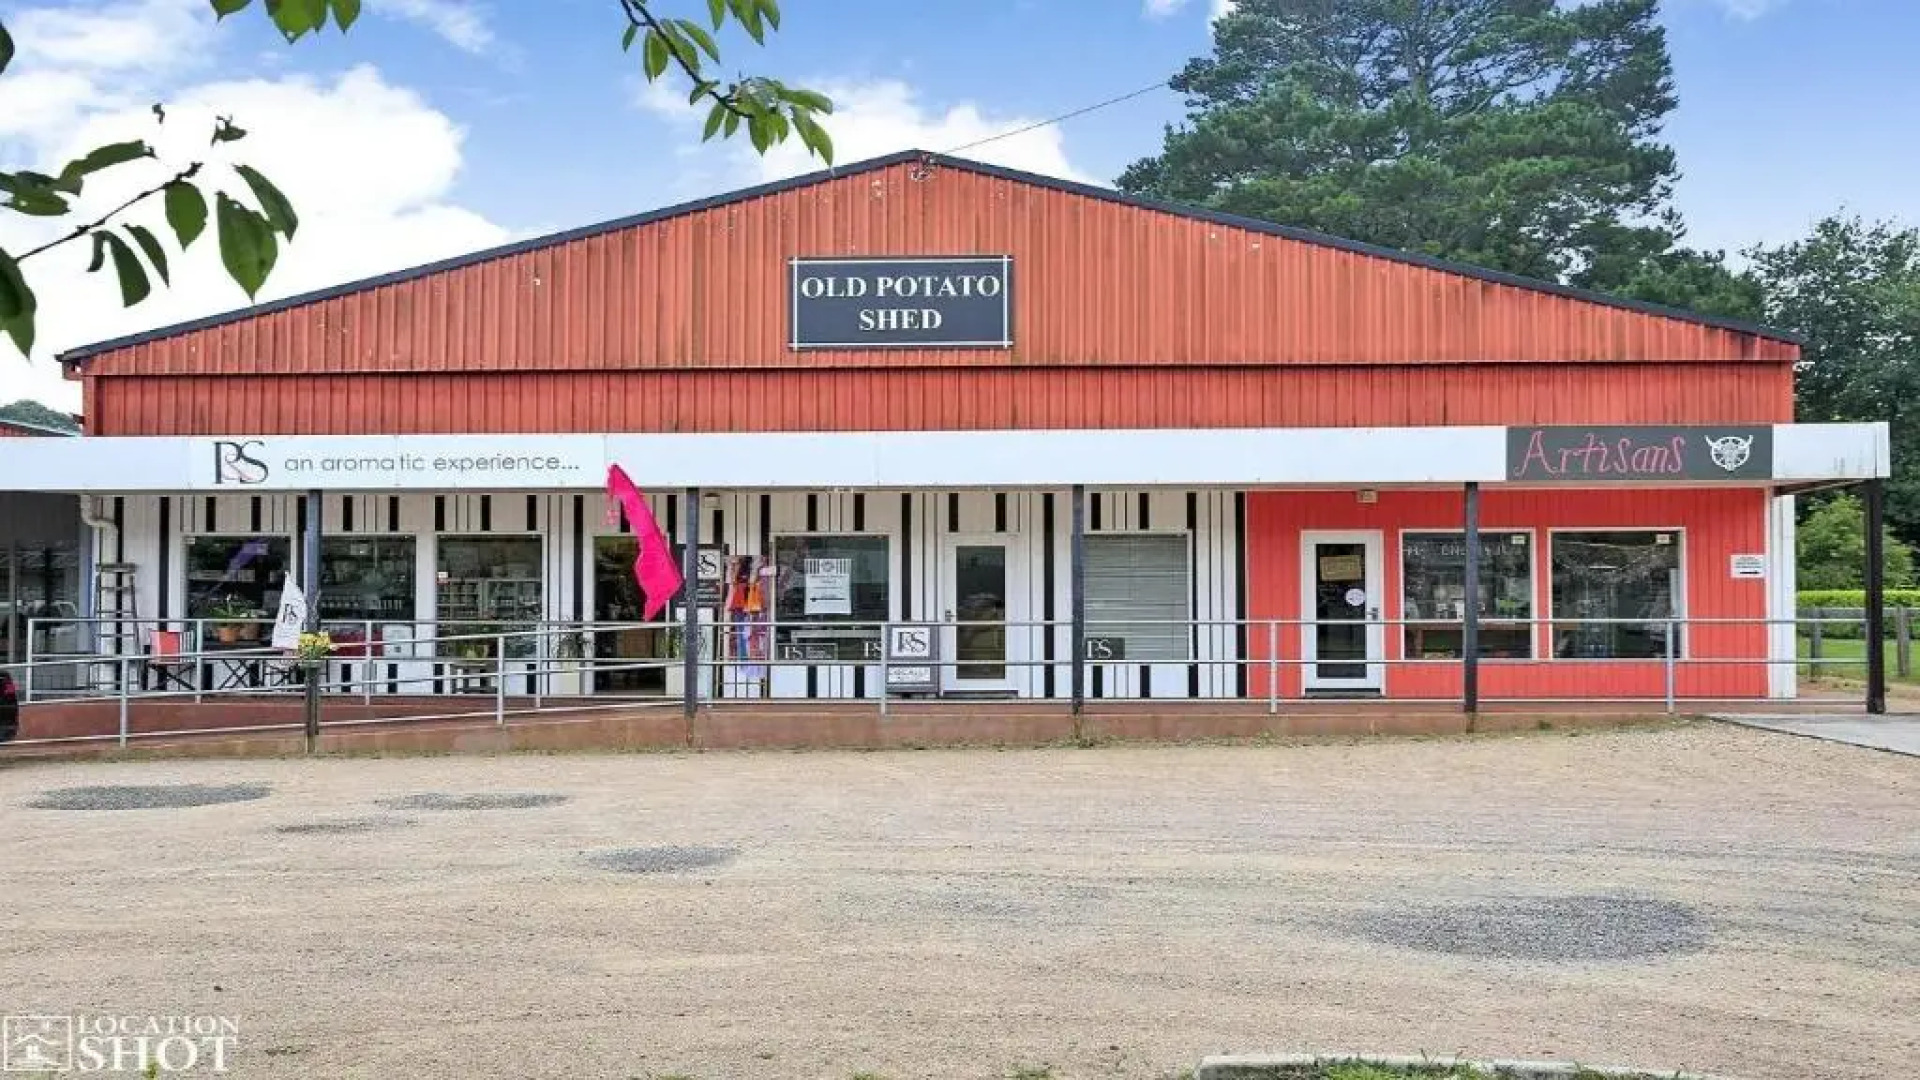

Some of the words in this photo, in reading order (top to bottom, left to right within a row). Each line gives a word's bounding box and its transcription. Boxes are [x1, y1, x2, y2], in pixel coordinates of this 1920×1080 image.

[801, 276, 868, 298] OLD
[876, 275, 1000, 298] POTATO
[858, 308, 942, 331] SHED
[284, 456, 314, 471] an
[433, 453, 580, 476] experience...
[1513, 430, 1686, 476] Artisans
